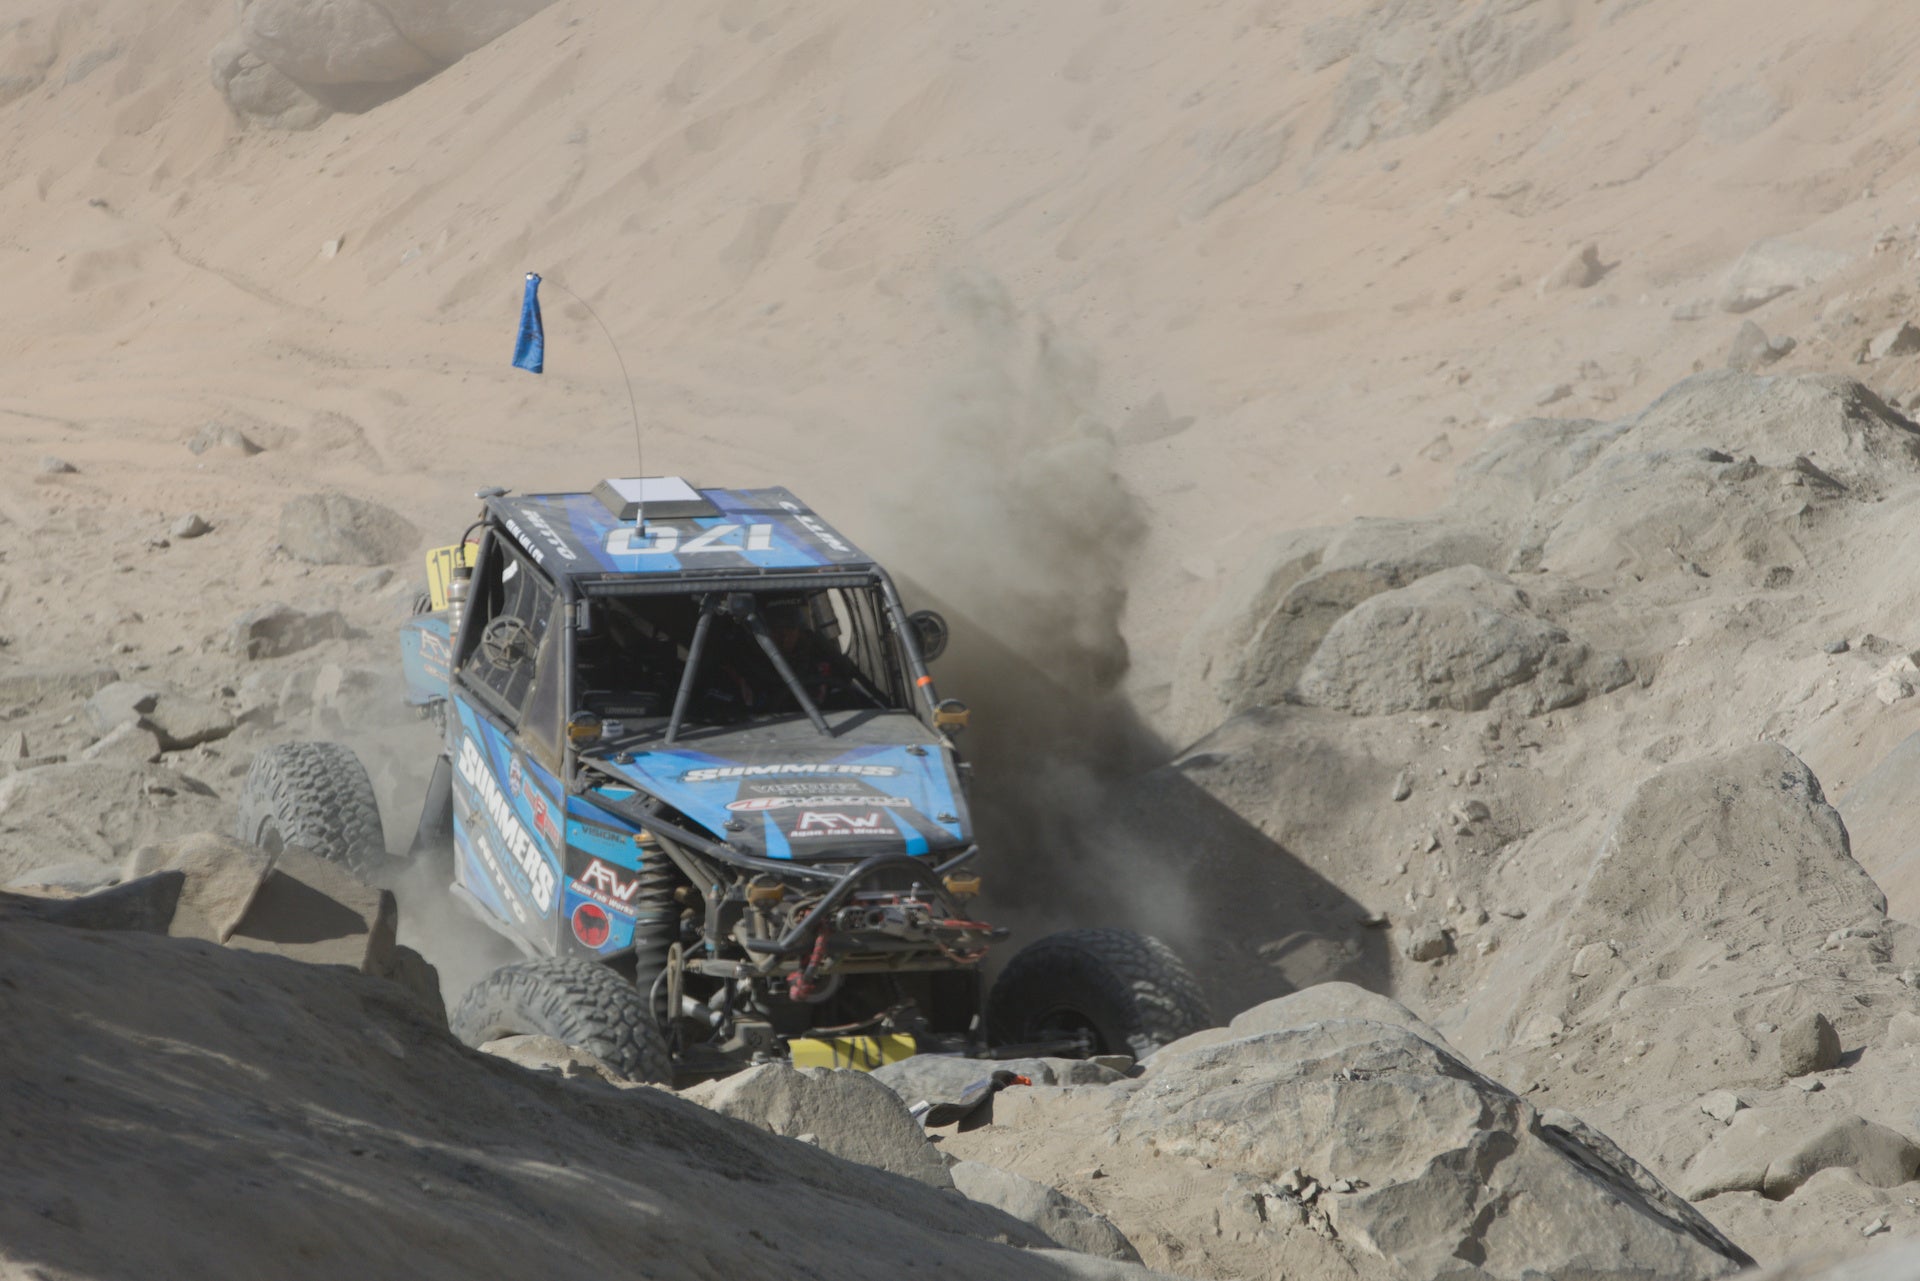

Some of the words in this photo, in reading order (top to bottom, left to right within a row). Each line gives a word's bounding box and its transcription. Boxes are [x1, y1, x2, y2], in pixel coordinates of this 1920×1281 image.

[605, 523, 774, 556] 170
[684, 763, 898, 783] SUMMERS
[458, 735, 556, 912] SUMMERS
[799, 811, 879, 830] AFW
[477, 835, 527, 924] NITTO
[581, 859, 639, 901] AFW
[608, 898, 634, 915] Works
